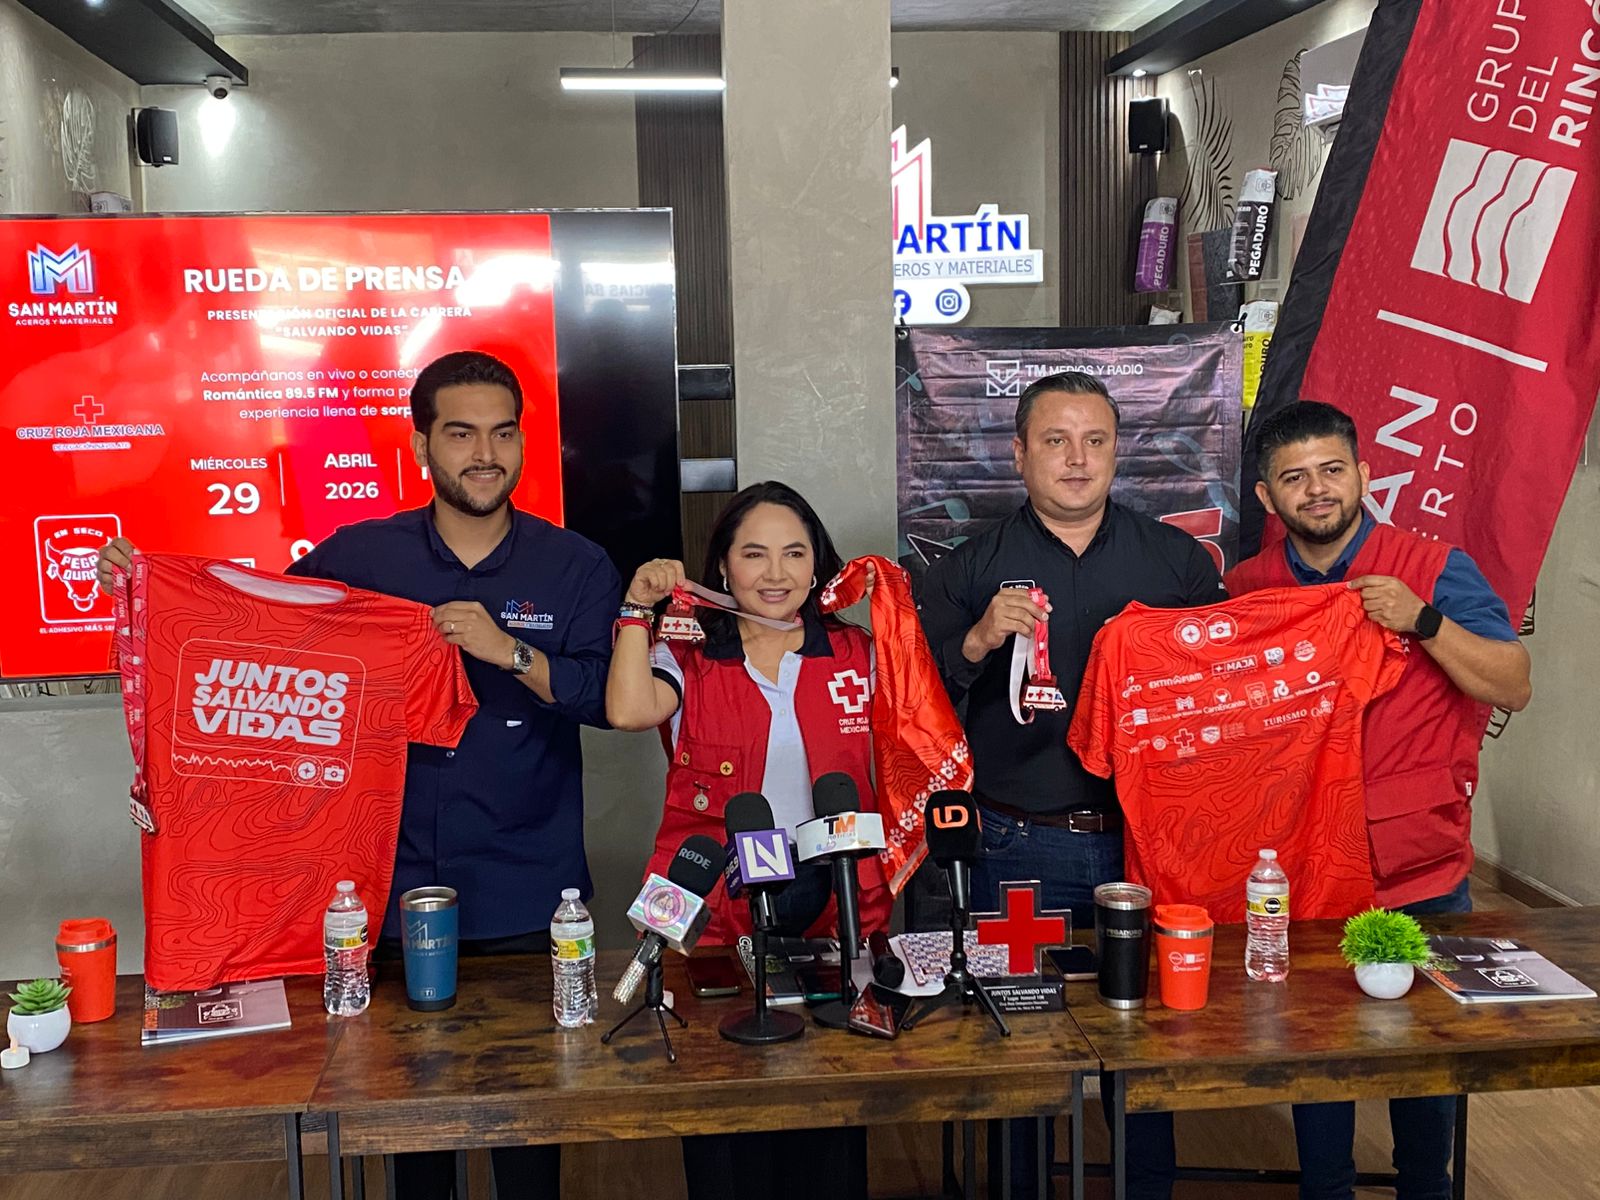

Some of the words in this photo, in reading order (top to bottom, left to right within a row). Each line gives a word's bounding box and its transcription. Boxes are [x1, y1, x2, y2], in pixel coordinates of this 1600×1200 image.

[1508, 56, 1558, 133] DEL
[1248, 205, 1269, 276] PEGADURO
[1153, 226, 1170, 287] PEGADURO
[935, 263, 943, 275] Y
[948, 259, 1032, 275] MATERIALES
[184, 268, 292, 293] RUEDA
[300, 268, 338, 292] DE
[346, 266, 467, 290] PRENSA
[8, 302, 44, 317] SAN
[49, 296, 118, 316] MARTÍN
[207, 306, 312, 320] PRESENIÓN
[315, 308, 367, 319] OFICIAL
[371, 308, 387, 318] DE
[391, 308, 407, 318] LA
[410, 307, 472, 318] CARRERA
[16, 318, 50, 326] ACEROS
[59, 317, 113, 325] MATERIALES
[201, 370, 303, 384] Acompáñanos
[327, 368, 355, 379] vivo
[360, 371, 367, 379] o
[1025, 365, 1046, 377] TM
[1049, 365, 1093, 375] MEDIOS
[1097, 365, 1104, 374] Y
[1107, 364, 1143, 375] RADIO
[203, 388, 282, 401] Romántica
[285, 387, 315, 399] 89.5
[318, 387, 338, 399] FM
[342, 389, 350, 400] y
[352, 386, 394, 397] forma
[239, 406, 319, 421] experiencia
[322, 405, 356, 417] llena
[360, 405, 377, 416] de
[16, 427, 53, 439] CRUZ
[55, 425, 91, 438] ROJA
[92, 424, 165, 437] MEXICANA
[190, 456, 268, 470] MIÉRCOLES
[324, 453, 377, 468] ABRIL
[1412, 402, 1478, 541] RTO
[207, 482, 260, 515] 29
[325, 482, 379, 500] 2026
[500, 611, 518, 620] SAN
[520, 612, 553, 622] MARTÍN
[48, 626, 83, 634] ADHESIVO
[84, 623, 102, 631] MÁS
[194, 659, 349, 699] JUNTOS
[192, 685, 345, 719] SALVANDO
[192, 706, 341, 746] VIDAS
[1263, 709, 1307, 727] TURISMO
[824, 815, 855, 834] TM
